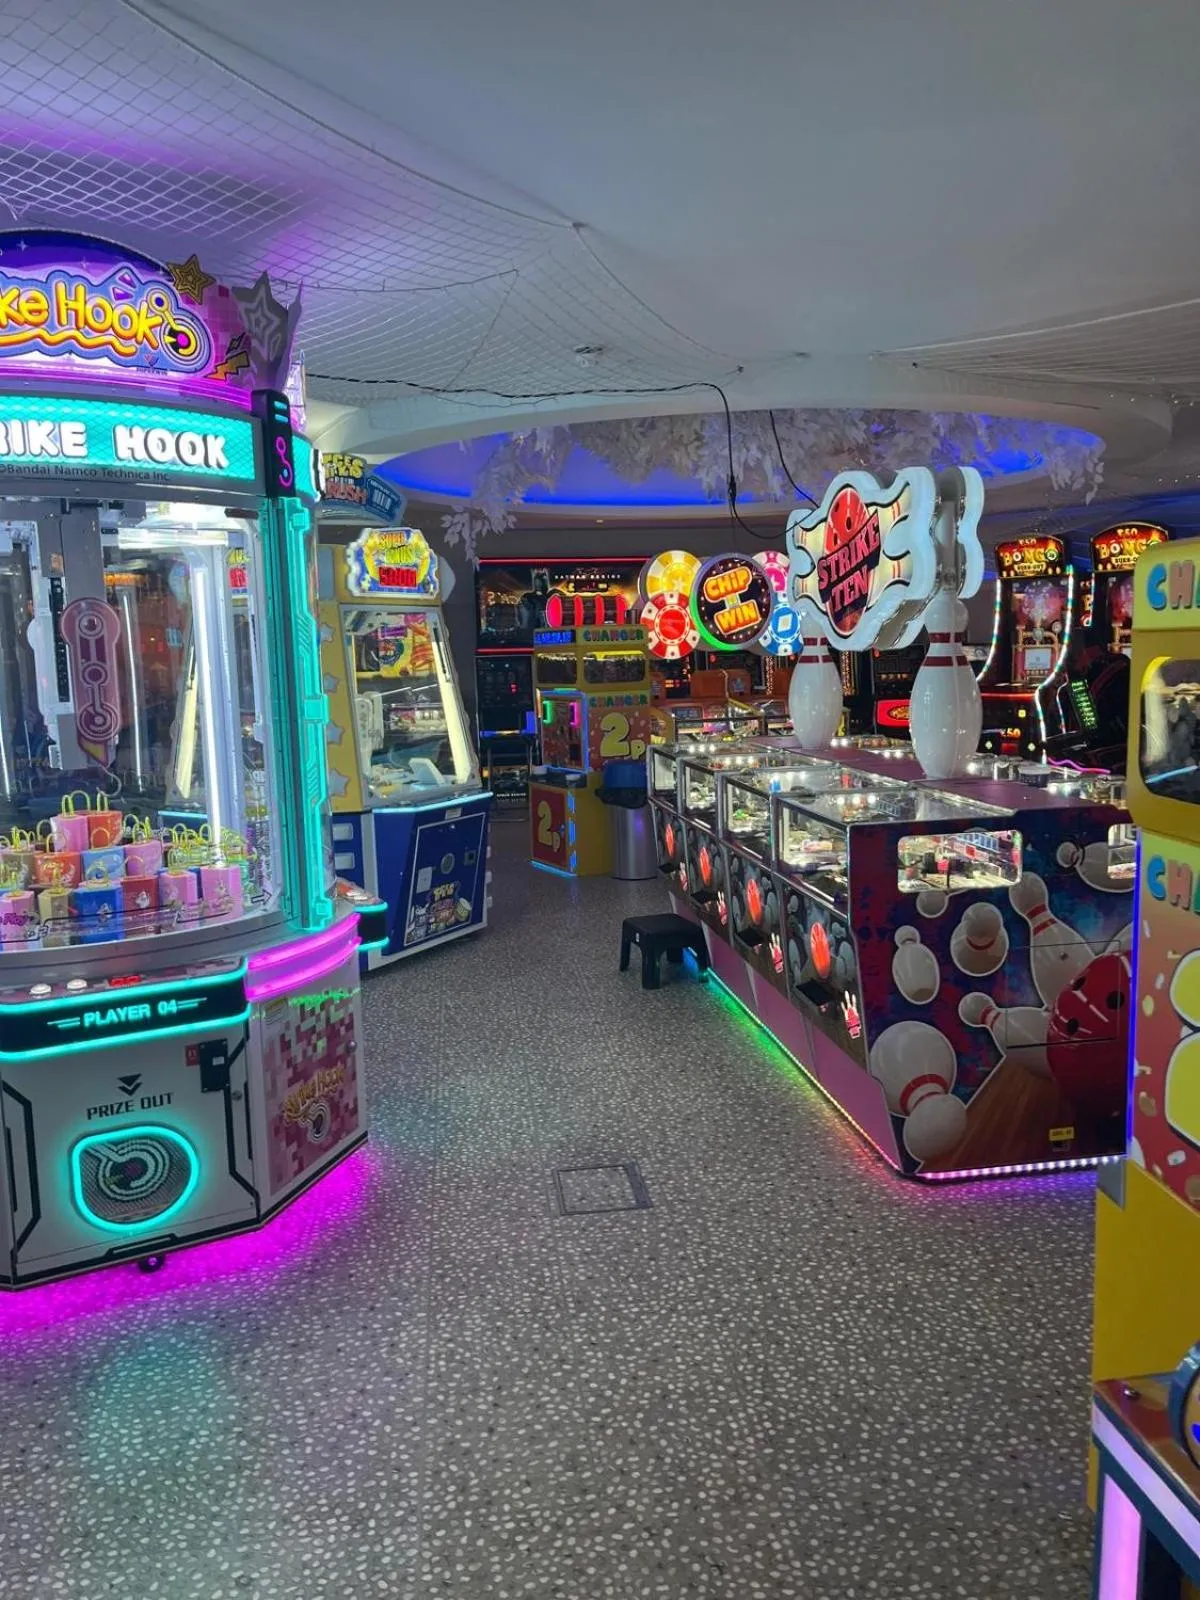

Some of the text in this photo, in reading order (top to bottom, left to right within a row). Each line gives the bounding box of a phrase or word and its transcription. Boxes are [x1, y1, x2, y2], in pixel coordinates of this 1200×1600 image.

[56, 280, 163, 350] Hook
[114, 424, 229, 469] HOOK
[55, 464, 97, 477] Namco
[101, 467, 150, 480] Technica
[818, 518, 880, 590] STRIKE
[1098, 539, 1158, 559] BONG
[831, 564, 869, 613] TEN
[1147, 559, 1200, 611] CH
[583, 629, 645, 642] CHANGER
[715, 600, 761, 635] WIN
[1147, 855, 1200, 915] CH
[83, 999, 178, 1028] PLAYER 04
[86, 1091, 175, 1121] PRIZE OUT
